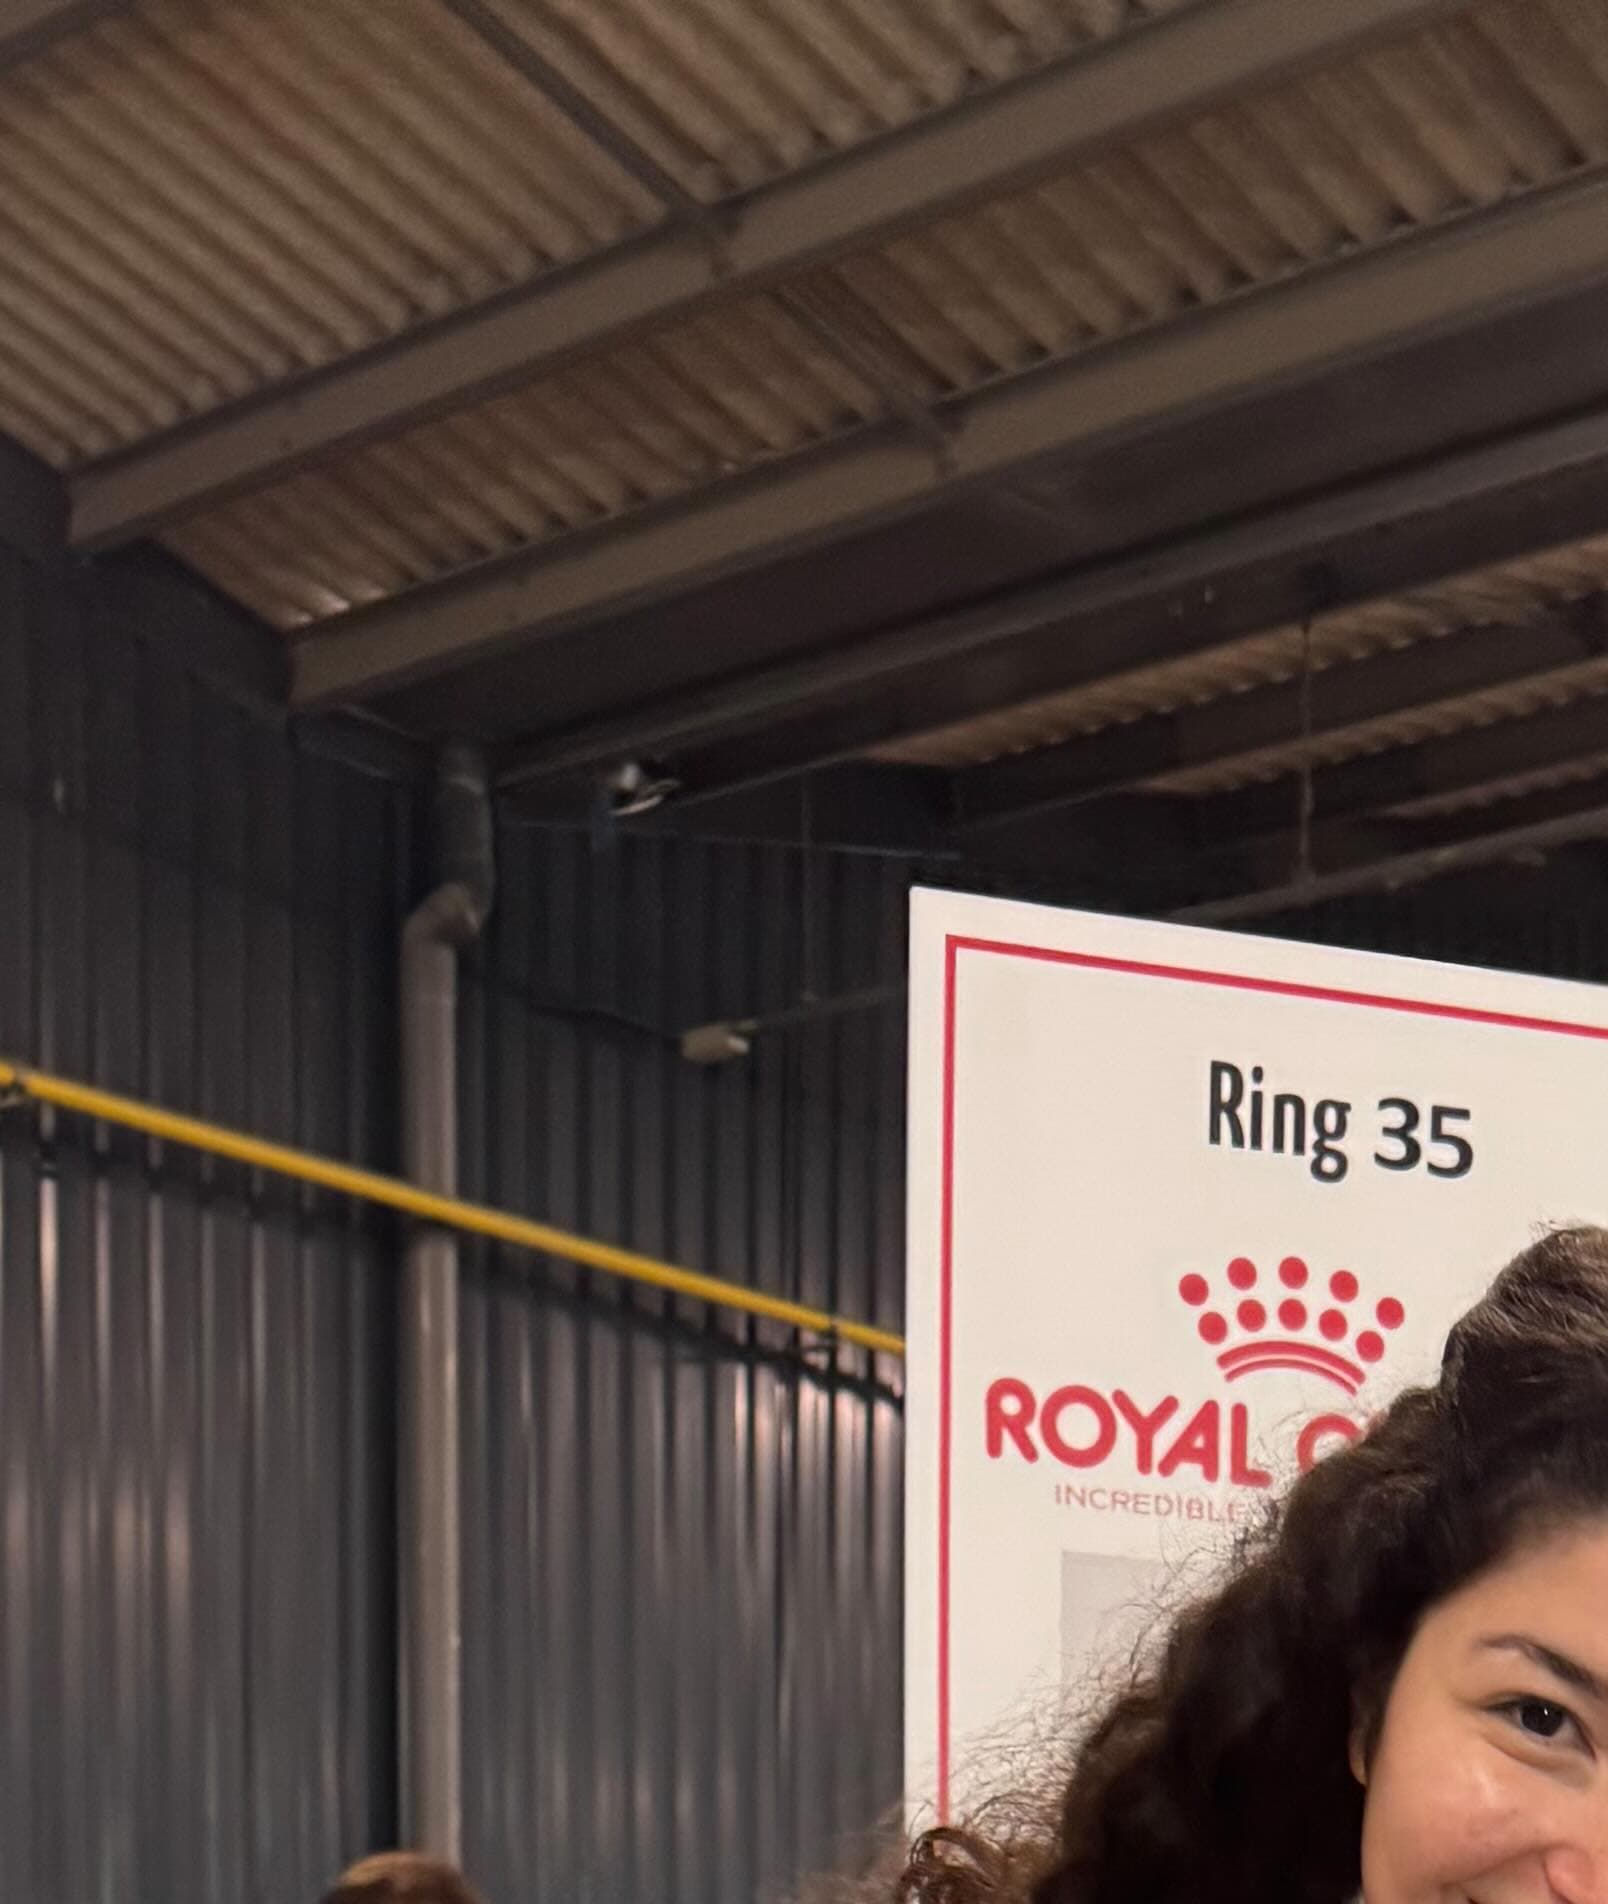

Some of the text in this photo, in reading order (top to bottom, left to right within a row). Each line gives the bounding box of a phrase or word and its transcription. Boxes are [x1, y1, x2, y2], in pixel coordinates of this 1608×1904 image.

[1209, 1060, 1474, 1183] Ring 35
[986, 1377, 1273, 1488] ROYAL
[1054, 1484, 1248, 1524] INCREDIBLE
